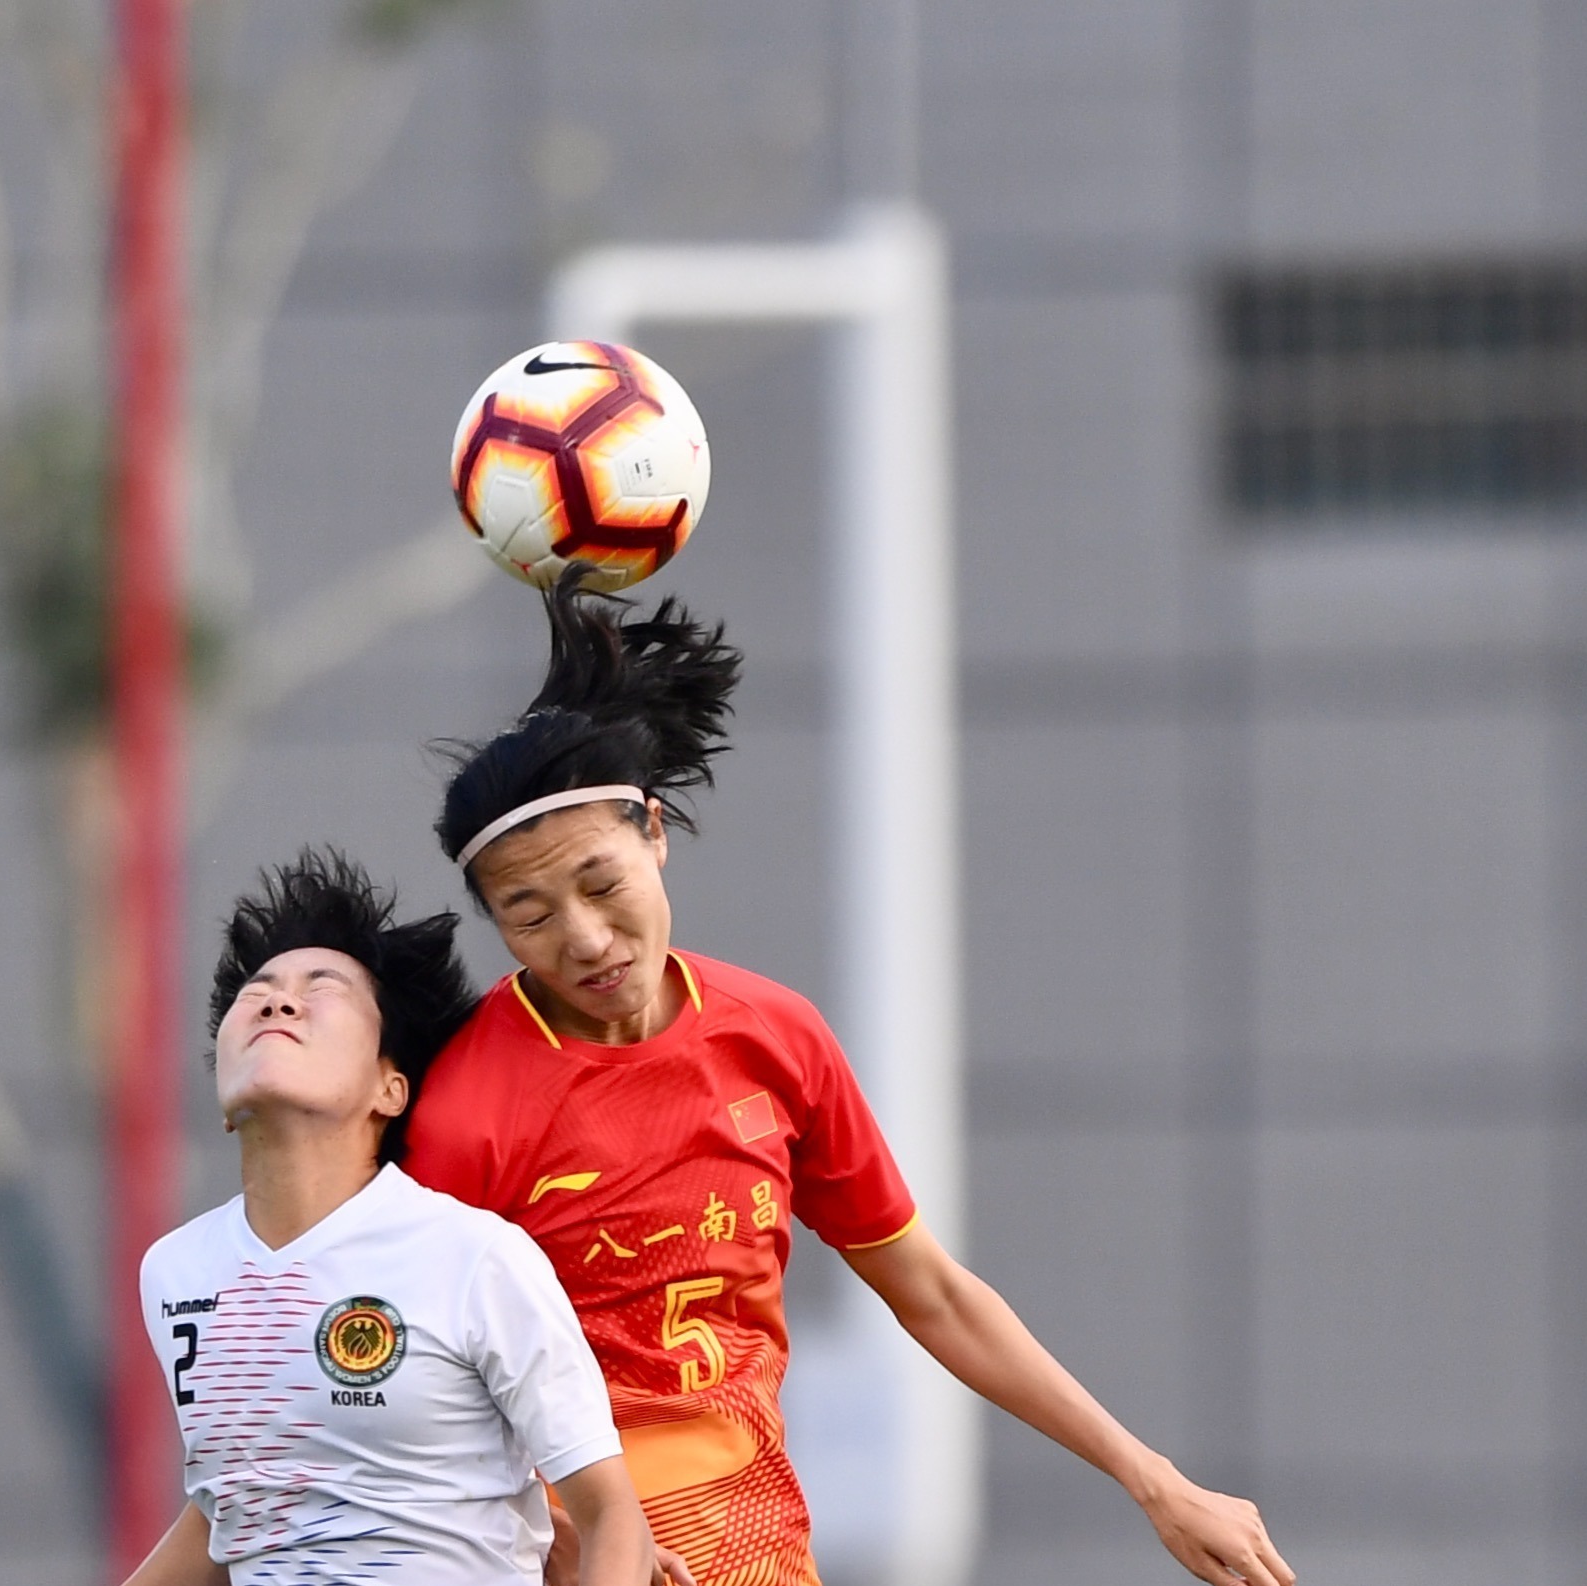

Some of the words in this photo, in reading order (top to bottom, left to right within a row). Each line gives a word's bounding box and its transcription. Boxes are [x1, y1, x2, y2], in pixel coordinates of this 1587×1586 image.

[583, 1181, 778, 1264] 八一南昌
[161, 1292, 220, 1319] hummel
[662, 1276, 726, 1394] 5
[173, 1322, 198, 1407] 2
[331, 1390, 387, 1407] KOREA
